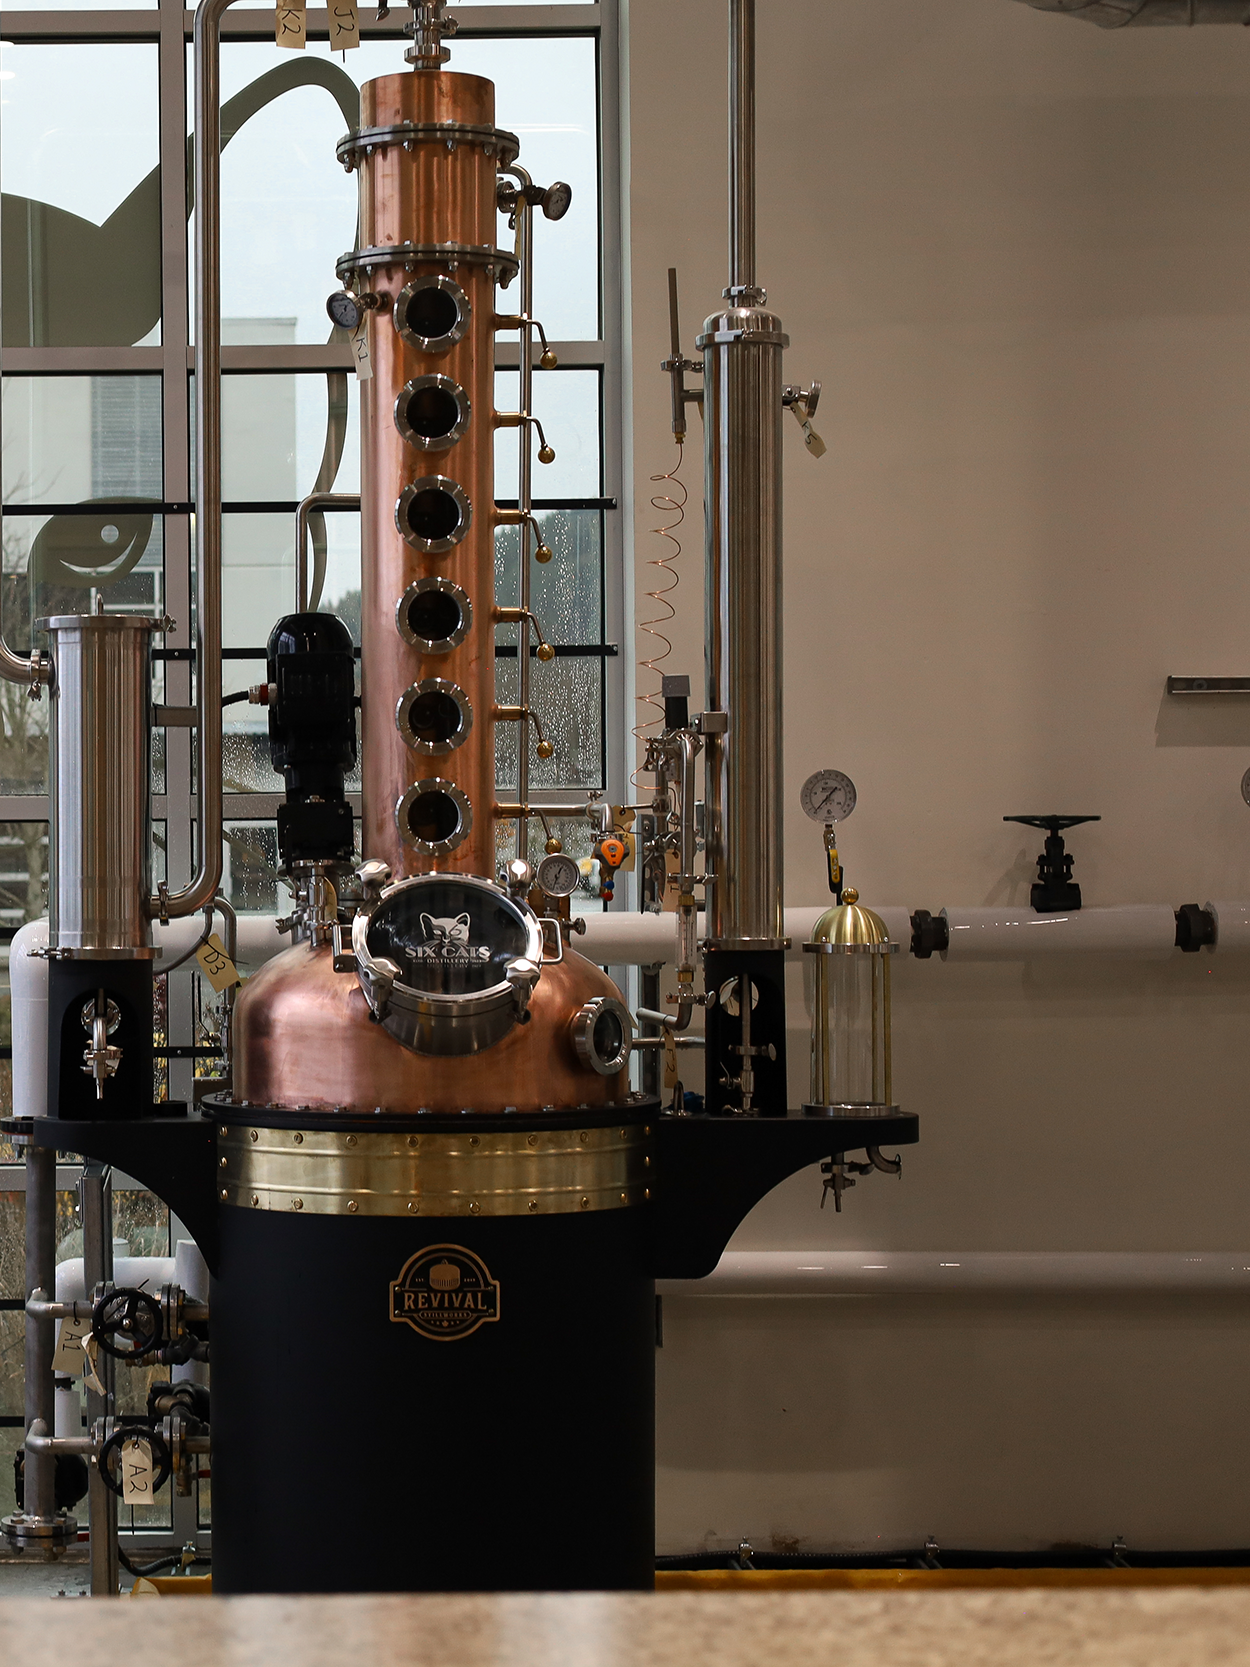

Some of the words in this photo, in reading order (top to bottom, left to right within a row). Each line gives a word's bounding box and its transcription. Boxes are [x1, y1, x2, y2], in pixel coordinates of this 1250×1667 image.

[282, 9, 303, 35] K2
[333, 6, 355, 36] J2
[356, 338, 369, 363] K1
[203, 950, 226, 975] D3
[405, 946, 437, 958] SIX
[441, 946, 490, 961] CATS
[403, 1292, 488, 1311] REVIVAL
[62, 1331, 82, 1351] A1
[129, 1464, 148, 1494] A2
